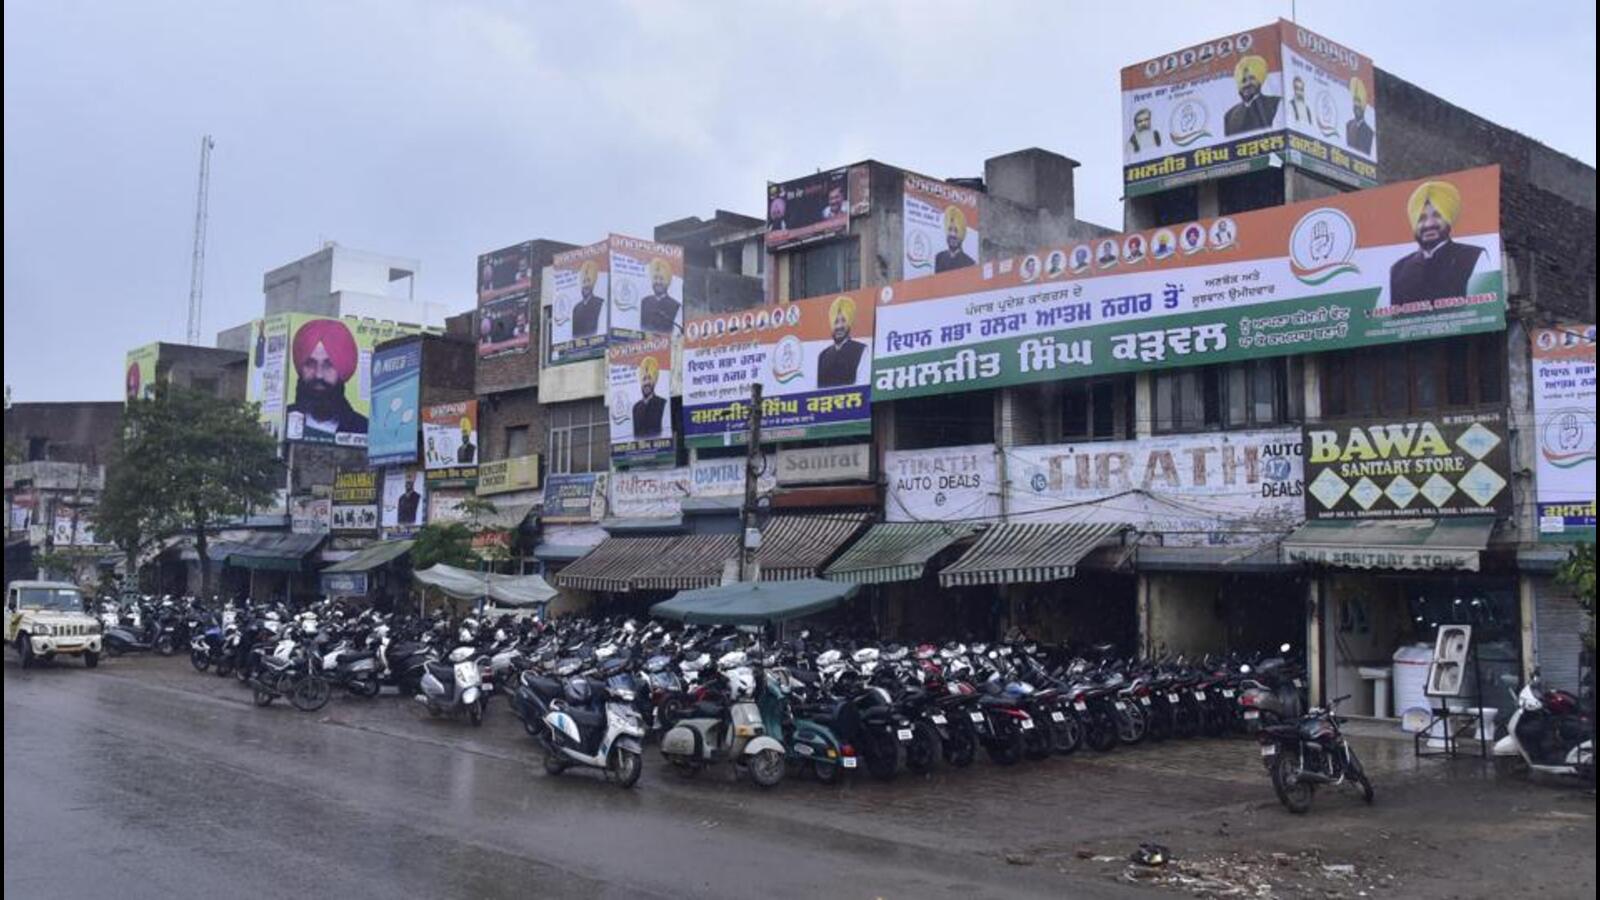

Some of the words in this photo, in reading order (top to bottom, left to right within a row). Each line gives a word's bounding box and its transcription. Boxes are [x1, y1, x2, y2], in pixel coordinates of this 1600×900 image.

[887, 331, 932, 352] ਵਿਧਾਨ
[940, 323, 972, 344] ਸਭਾ
[980, 313, 1027, 337] ਹਲਕਾ
[1036, 302, 1092, 327] ਆਤਮ
[1101, 293, 1152, 319] ਨਗਰ
[876, 349, 1000, 391] ਕਮਲਜੀਤ
[1017, 336, 1093, 373] ਸਿੰਘ
[1111, 322, 1228, 363] ਕੜਵਲ
[806, 392, 863, 414] ਕੜਵਲ
[1262, 443, 1303, 457] AUTO
[1308, 421, 1452, 463] BAWA
[899, 454, 978, 476] TIRATH
[1042, 446, 1259, 491] TIRATH
[1341, 460, 1411, 477] SANITARY
[1415, 457, 1465, 473] STORE
[897, 477, 932, 491] AUTO
[939, 474, 980, 490] DEALS
[1262, 481, 1303, 497] DEALS
